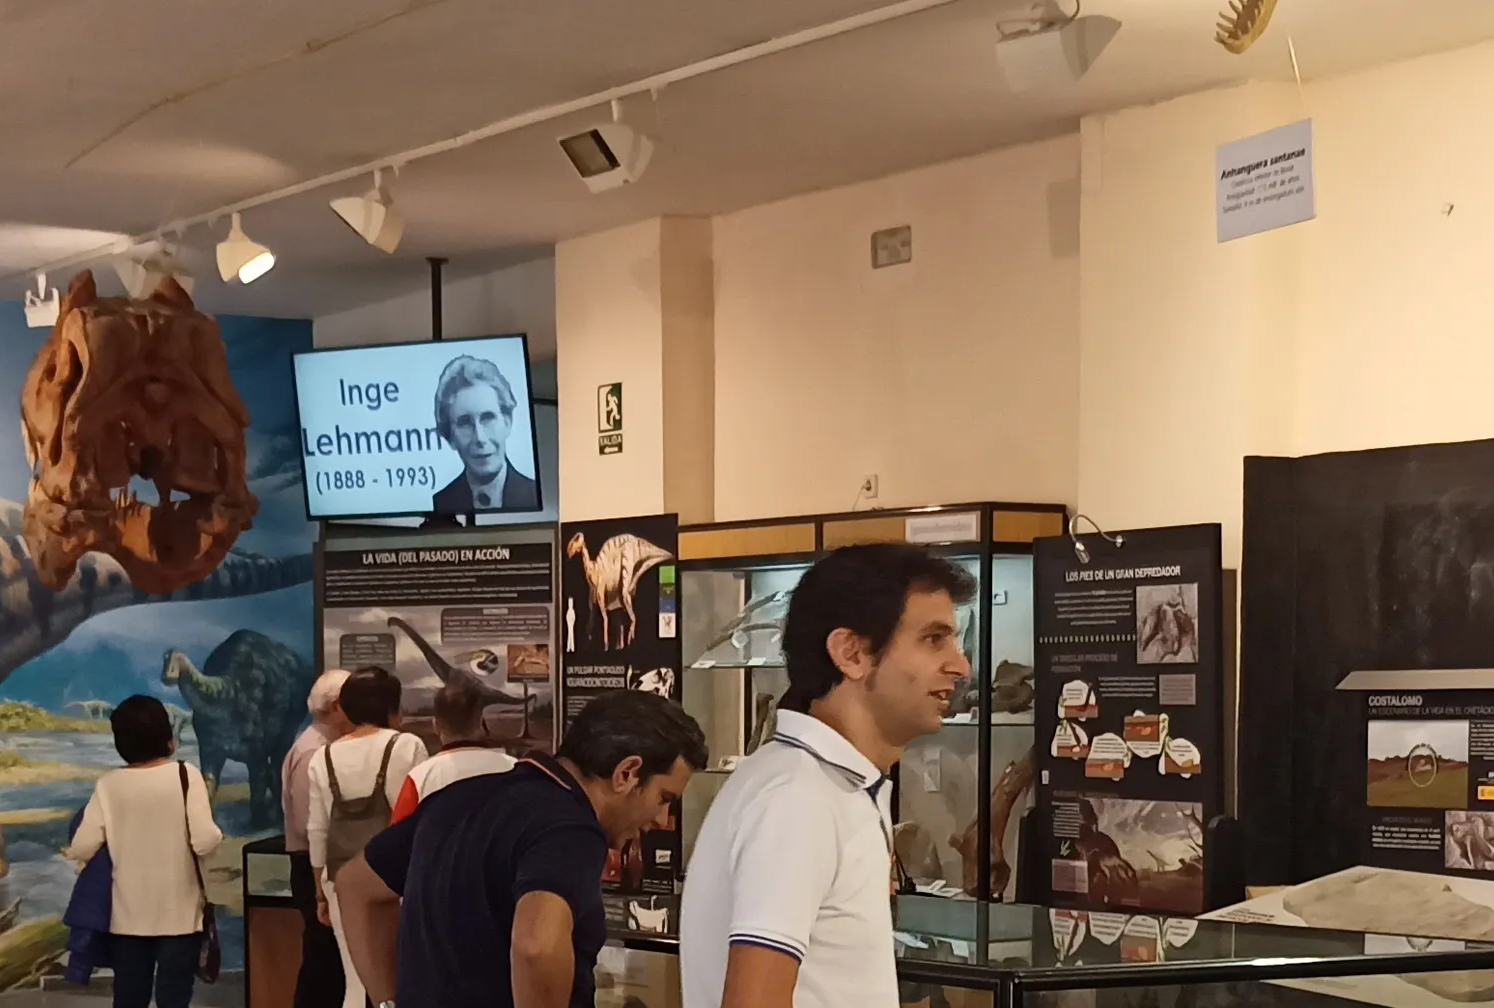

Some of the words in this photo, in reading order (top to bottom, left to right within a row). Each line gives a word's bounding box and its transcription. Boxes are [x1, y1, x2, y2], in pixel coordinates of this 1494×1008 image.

[339, 378, 400, 411] Inge
[303, 424, 443, 457] Lehmann
[315, 470, 366, 495] (1888
[386, 466, 436, 490] 1993)
[362, 553, 374, 565] LA
[375, 552, 397, 565] VIDA
[399, 551, 418, 566] (DEL
[419, 549, 459, 565] PASADO)
[460, 549, 474, 562] EN
[475, 546, 510, 561] ACCIÓN
[1065, 571, 1078, 582] LOS
[1105, 570, 1115, 580] UN
[1116, 568, 1134, 579] GRAN
[1135, 565, 1181, 579] DEPREDADOR
[1368, 695, 1423, 706] COSTALOMO
